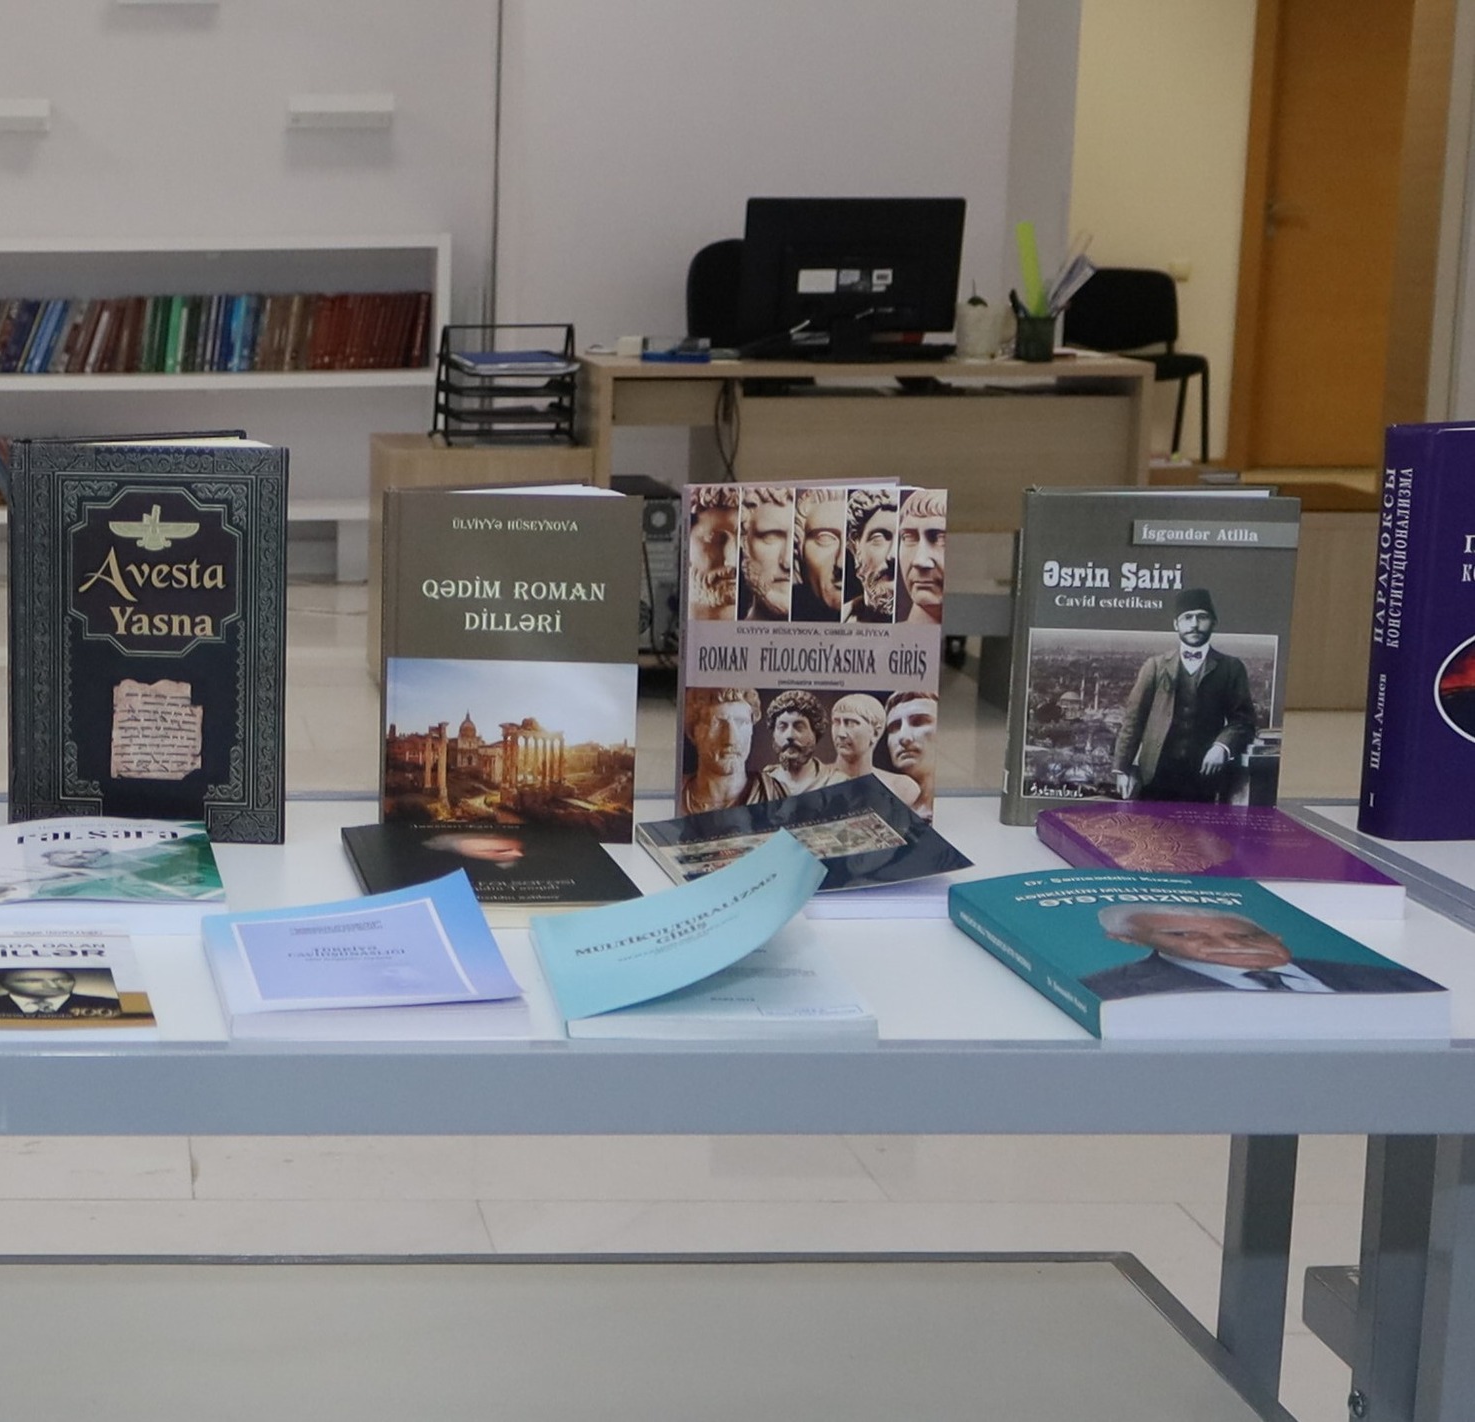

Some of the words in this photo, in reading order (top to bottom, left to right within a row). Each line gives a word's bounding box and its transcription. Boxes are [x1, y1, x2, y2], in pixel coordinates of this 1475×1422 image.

[507, 518, 579, 532] HÜSEYNOVA
[1216, 526, 1259, 542] Atilla
[1373, 468, 1397, 644] ПАРАДОКСЫ
[1386, 467, 1414, 649] КОНСТИТУЦИОНАЛИЗМА
[78, 546, 226, 602] Avesta
[422, 576, 501, 600] QƏDİM
[513, 581, 606, 602] ROMAN
[1042, 560, 1110, 588] Əsrin
[1120, 563, 1183, 592] Şairi
[109, 606, 214, 637] Yasna
[464, 607, 563, 634] DİLLƏRİ
[698, 646, 749, 673] ROMAN
[759, 641, 877, 674] FİLOLOGİYASINA
[887, 643, 928, 681] GİRİŞ
